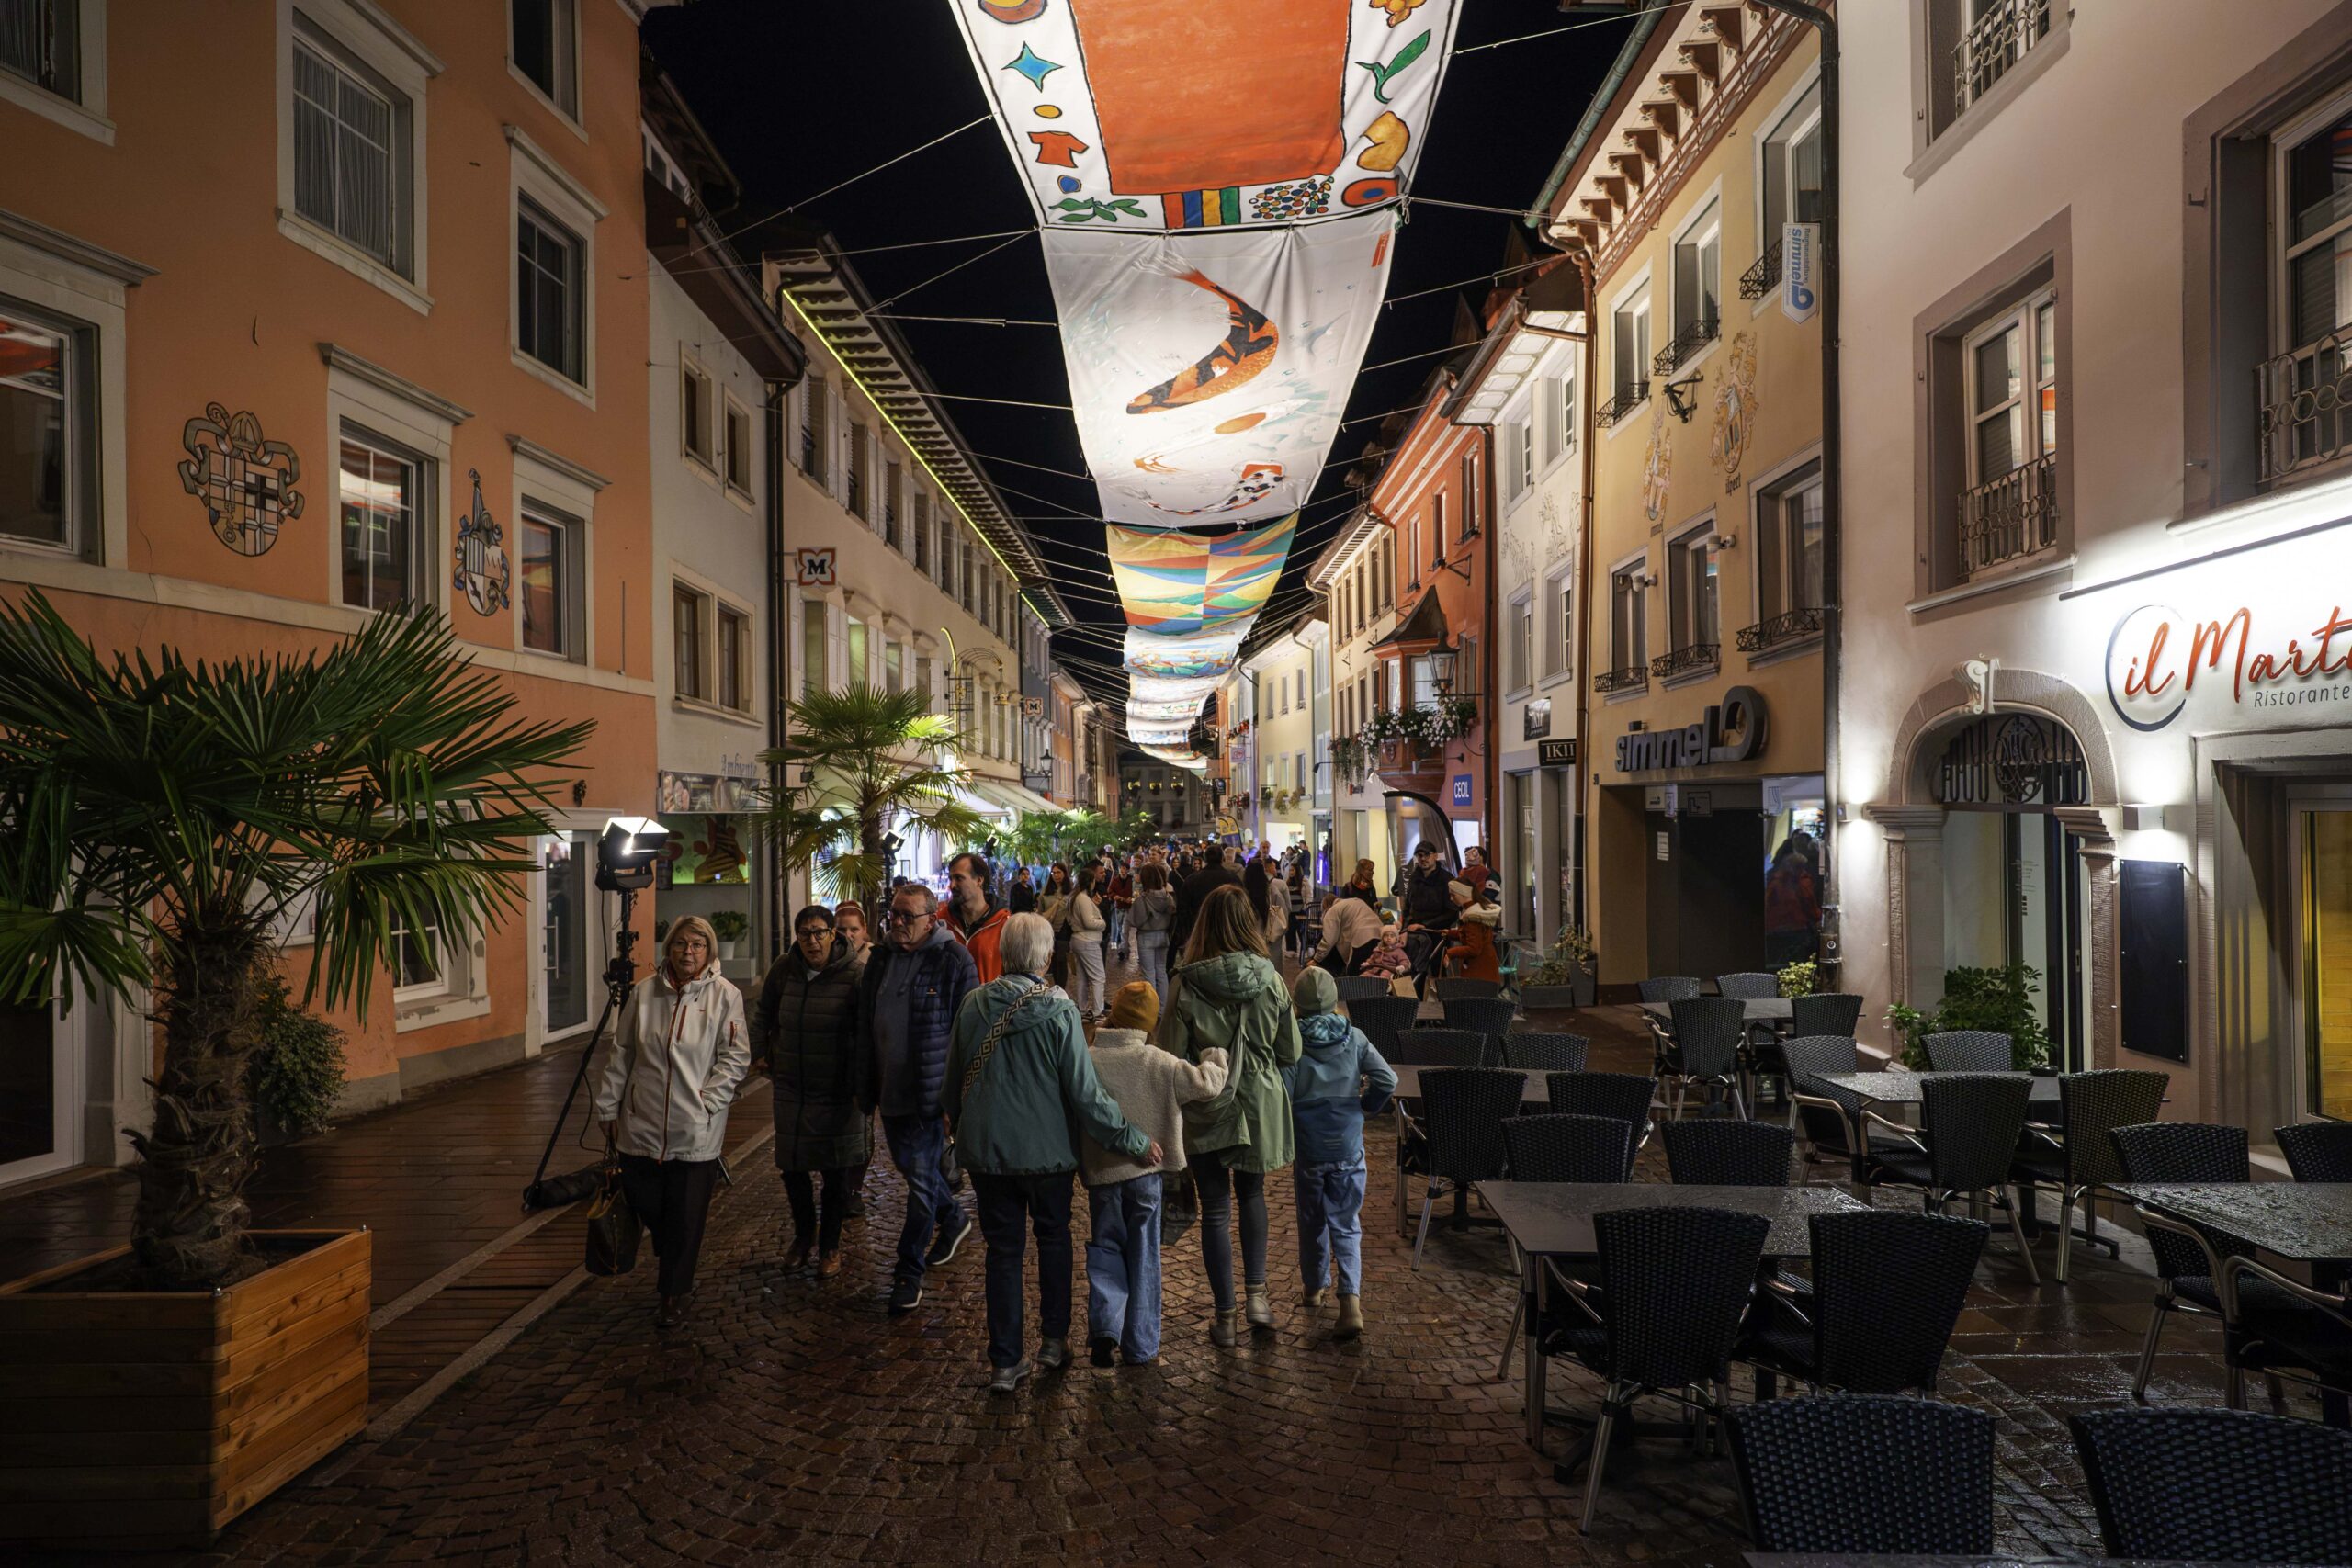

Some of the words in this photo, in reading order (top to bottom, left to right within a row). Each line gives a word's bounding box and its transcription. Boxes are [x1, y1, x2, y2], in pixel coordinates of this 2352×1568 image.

[1792, 228, 1804, 286] simmel
[807, 559, 827, 575] M
[2124, 622, 2175, 696] il
[2185, 606, 2352, 704] Mart
[2254, 683, 2351, 708] Ristorante
[1615, 706, 1720, 773] simmel
[1453, 781, 1470, 798] CECIL
